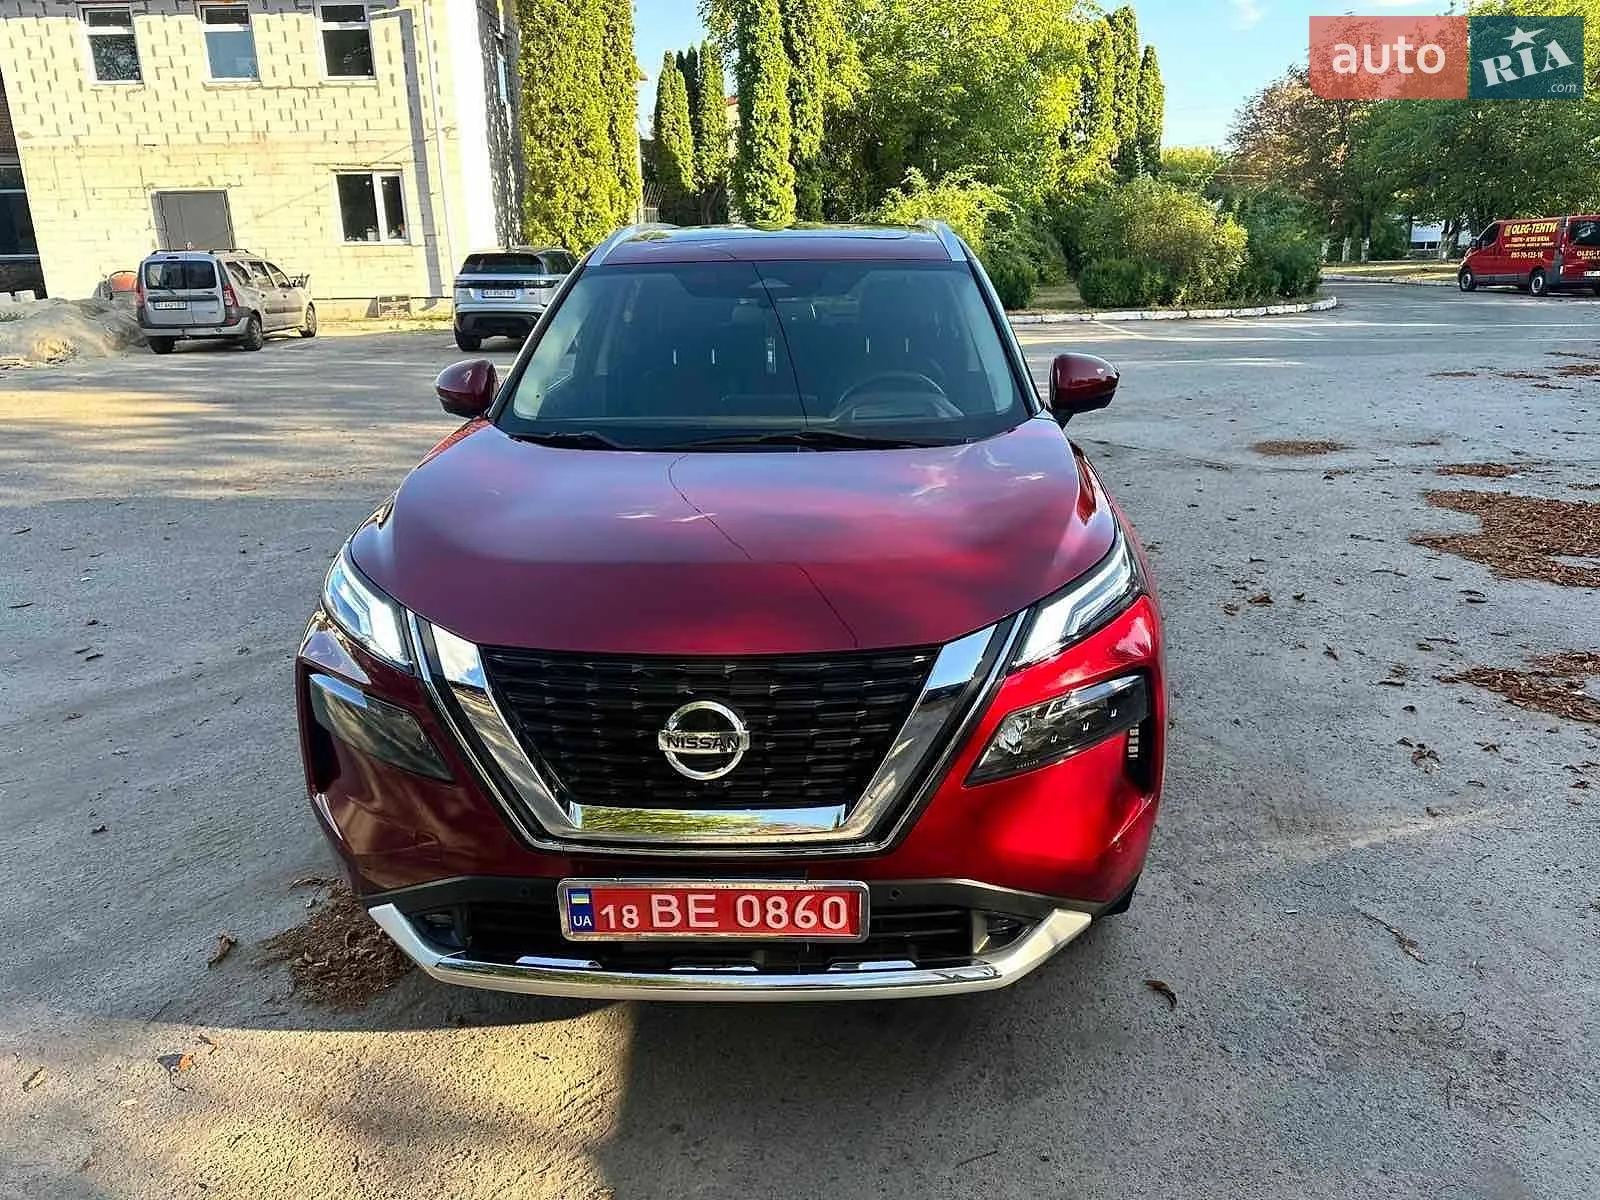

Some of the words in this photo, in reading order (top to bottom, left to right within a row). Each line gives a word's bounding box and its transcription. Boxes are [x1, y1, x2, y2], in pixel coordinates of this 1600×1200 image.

[667, 737, 740, 749] NISSAN
[599, 904, 640, 930] 18
[650, 894, 719, 928] BE
[735, 895, 848, 930] 0860
[573, 915, 593, 928] UA
